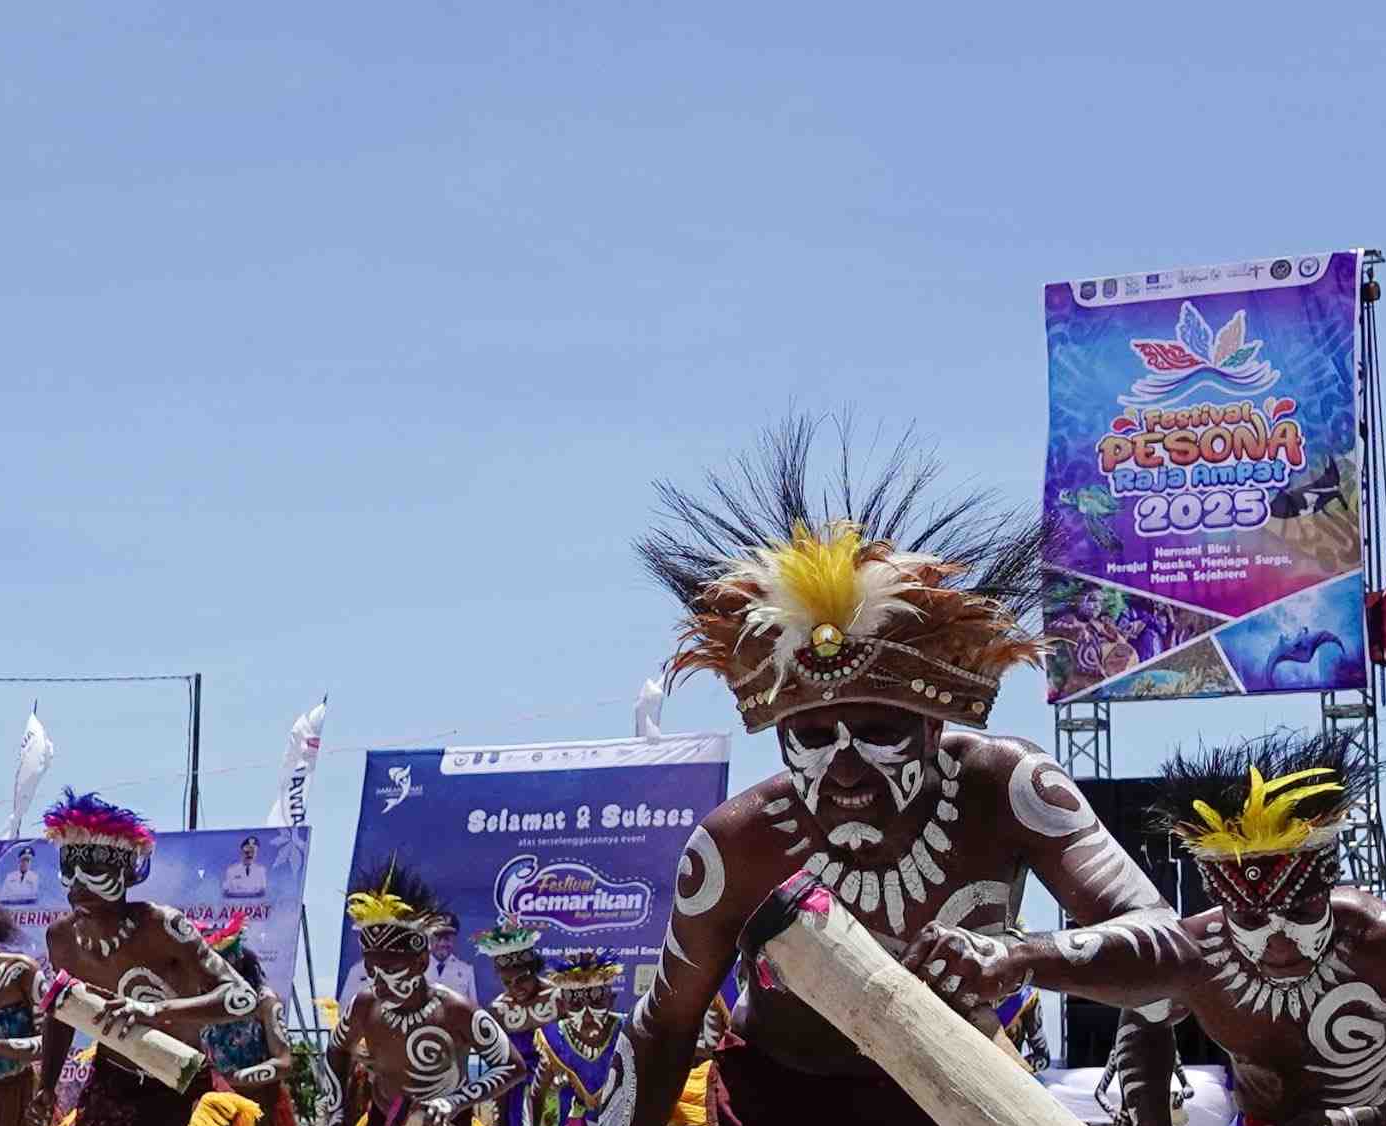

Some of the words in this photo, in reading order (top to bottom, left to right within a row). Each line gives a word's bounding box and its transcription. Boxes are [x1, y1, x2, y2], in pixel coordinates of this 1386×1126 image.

[1144, 401, 1252, 431] Festival
[1098, 414, 1303, 473] PESONA
[1113, 465, 1187, 492] Raja
[1191, 459, 1286, 488] Ampat
[1137, 489, 1268, 532] 2025
[1154, 544, 1202, 558] Harmoni
[1207, 543, 1231, 554] Biru
[1106, 561, 1147, 574] Merajut
[1152, 559, 1196, 571] Pusaka,
[1201, 556, 1249, 570] Menjaga
[467, 808, 566, 833] Selamat
[576, 805, 591, 830] &
[601, 804, 695, 829] Sukses
[621, 834, 646, 844] event
[537, 873, 597, 893] Festival
[517, 888, 643, 912] Gemarikan
